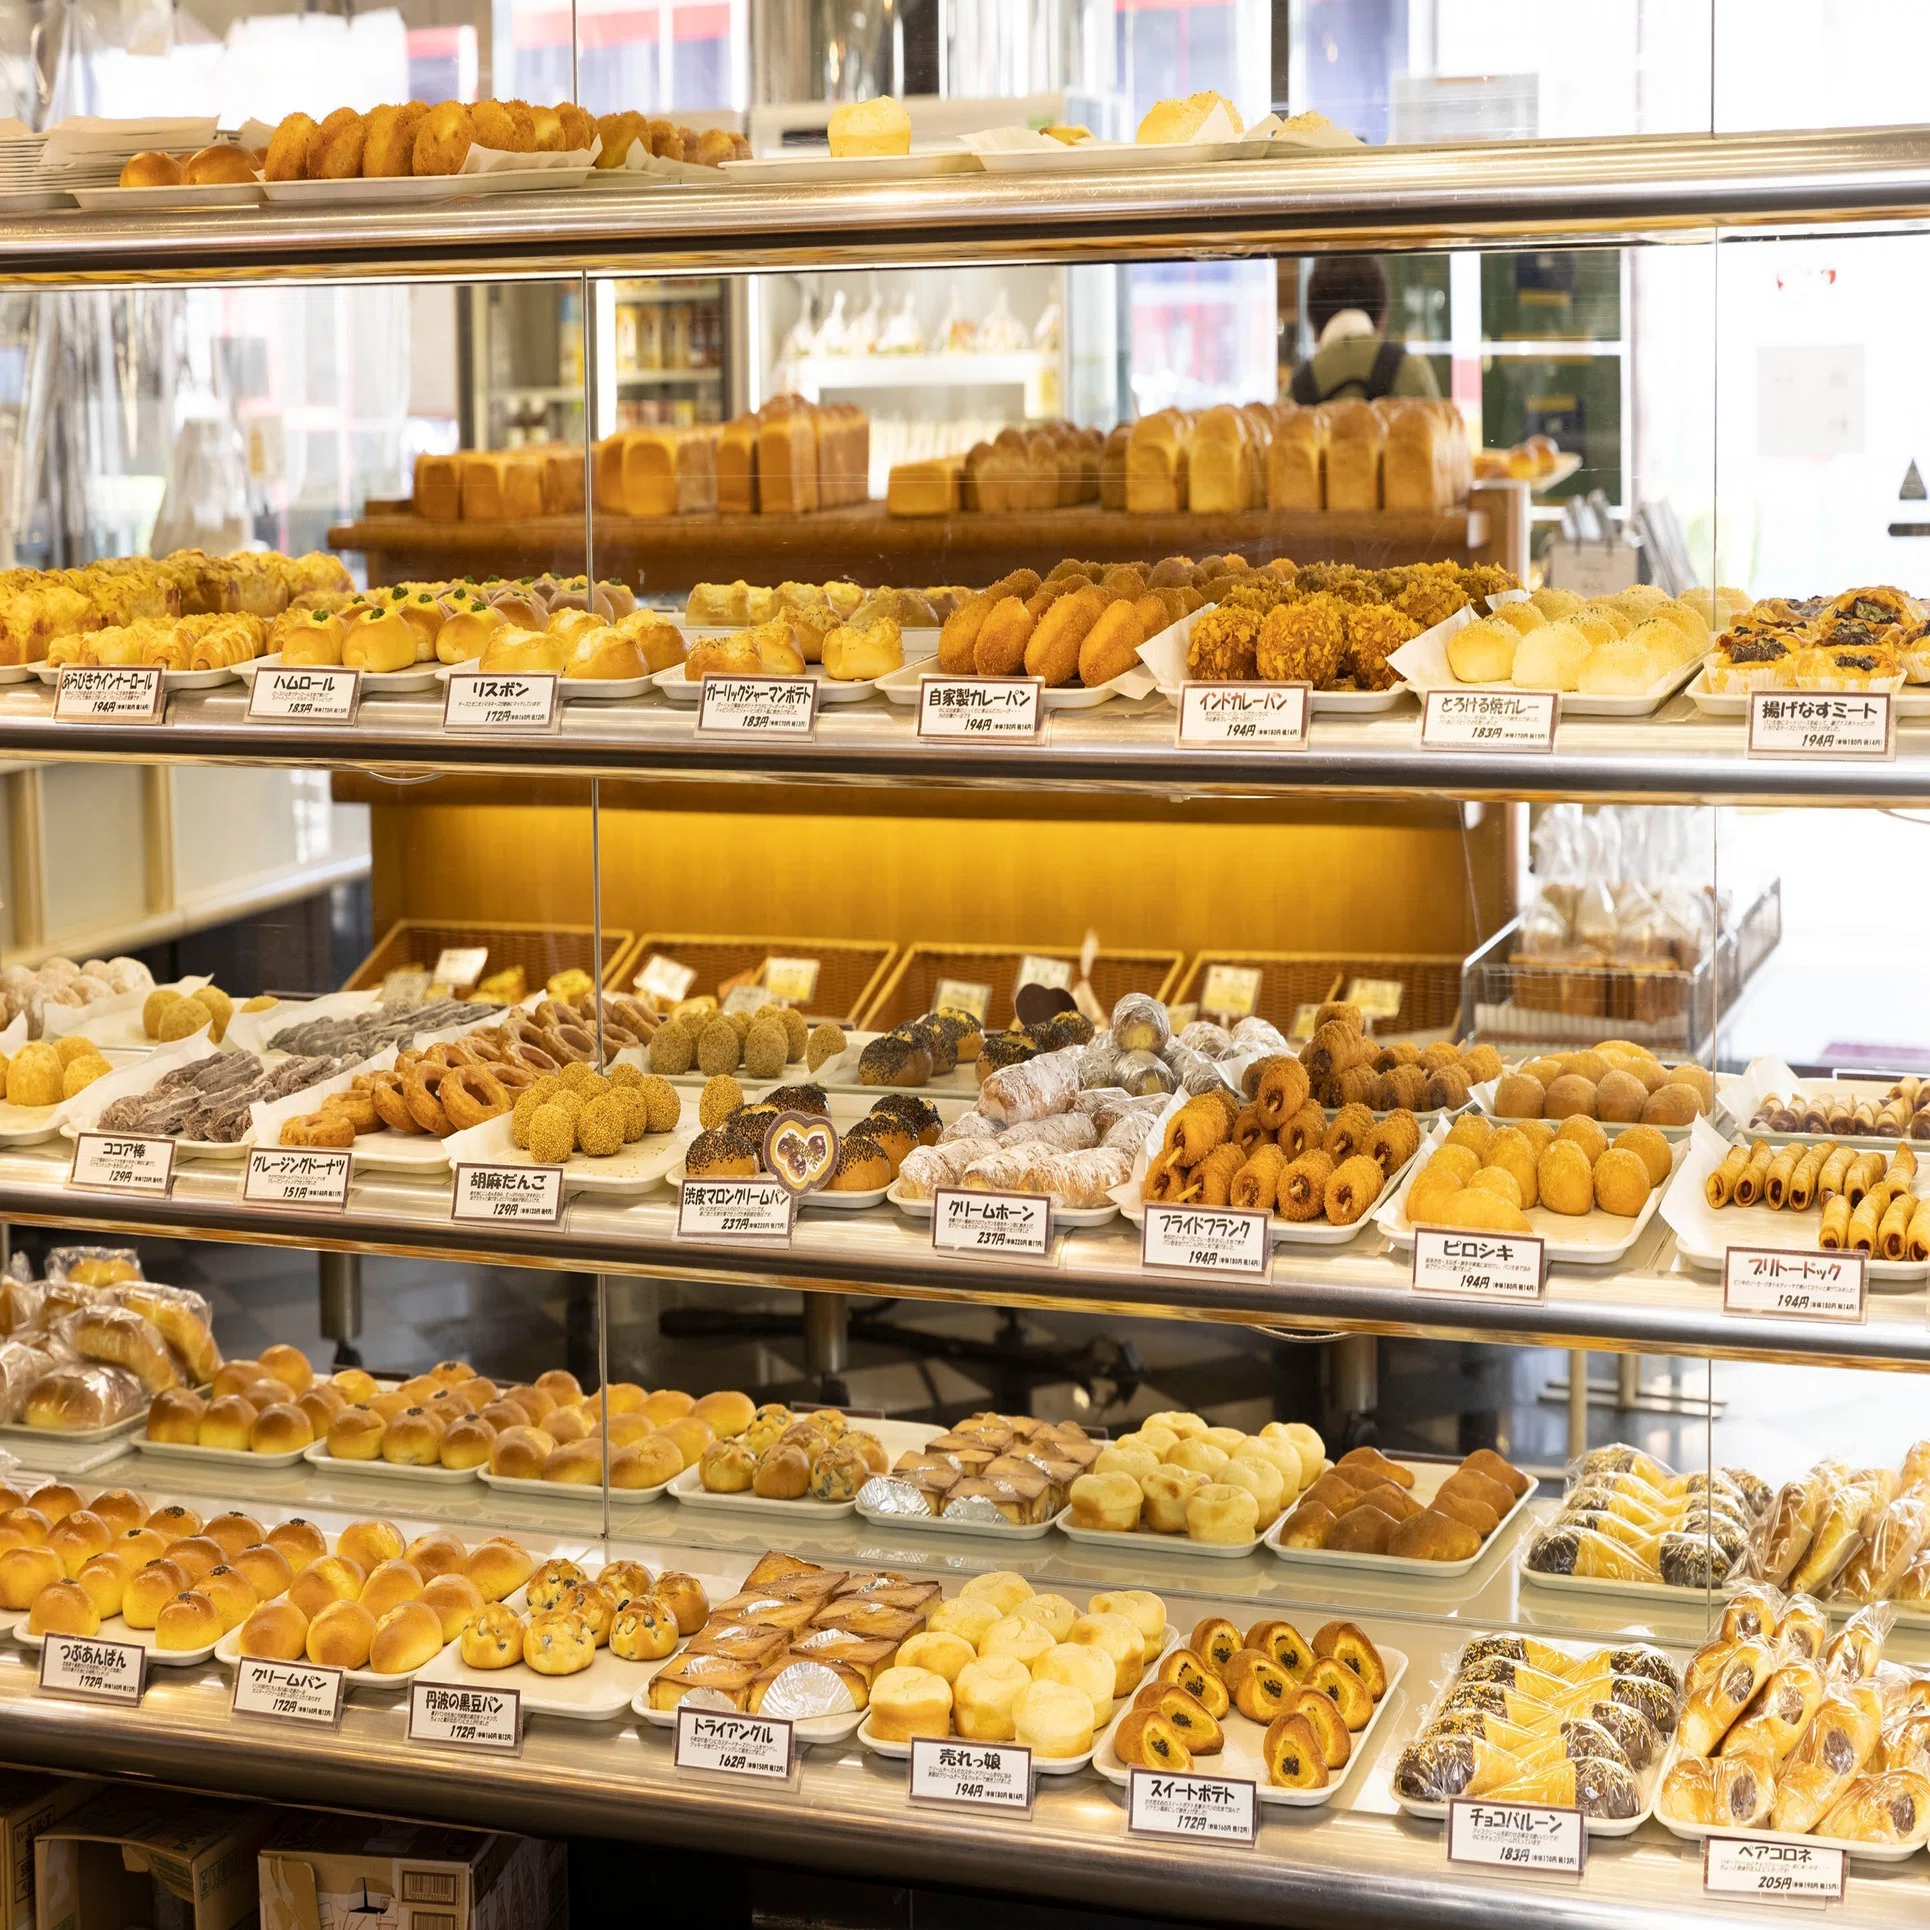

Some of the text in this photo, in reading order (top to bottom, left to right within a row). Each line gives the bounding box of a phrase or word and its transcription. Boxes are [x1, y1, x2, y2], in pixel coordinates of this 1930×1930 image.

[62, 672, 152, 690] あらびきウインナーロール
[273, 675, 335, 691] ハムロール
[473, 682, 529, 697] リスボン
[707, 684, 811, 704] ガーリックジャーマンポテト
[929, 688, 1030, 707] 自家製カレーパン
[1200, 692, 1287, 710] インドカレーパン
[92, 701, 116, 712] 194円
[288, 703, 313, 713] 183円
[1441, 697, 1539, 714] とろける焼カレー
[1762, 700, 1877, 719] 揚げなすミート
[485, 710, 511, 722] 172円
[742, 716, 769, 727] 183円
[965, 719, 992, 730] 194円
[1227, 724, 1256, 736] 194円
[1472, 727, 1502, 738] 183円
[1802, 734, 1834, 747] 194円
[103, 1143, 146, 1158] ココア棒
[253, 1156, 345, 1175] グレージングドーナツ
[109, 1170, 132, 1182] 129円
[470, 1172, 547, 1190] 胡麻だんご
[283, 1186, 308, 1198] 151円
[685, 1187, 789, 1205] 渋皮マロンクリームパン
[493, 1203, 519, 1215] 129円
[949, 1200, 1034, 1222] クリームホーン
[721, 1218, 749, 1230] 237円
[1160, 1215, 1250, 1238] フライドフランク
[977, 1232, 1006, 1245] 237円
[1189, 1251, 1218, 1265] 194円
[1444, 1240, 1514, 1261] ピロシキ
[1748, 1258, 1842, 1281] ブリトードック
[1461, 1275, 1490, 1289] 194円
[1778, 1294, 1810, 1309] 194円
[61, 1645, 126, 1668] つぶあんぱん
[79, 1675, 103, 1688] 172円
[252, 1668, 327, 1690] クリームパン
[273, 1698, 298, 1713] 172円
[426, 1690, 503, 1714] 丹波の黒豆パン
[450, 1725, 476, 1739] 172円
[695, 1717, 773, 1744] トライアングル
[719, 1754, 746, 1769] 162円
[940, 1748, 1001, 1770] 売れっ娘
[955, 1783, 984, 1797] 194円
[1151, 1780, 1235, 1804] スイートポテト
[1177, 1815, 1207, 1831] 172円
[1470, 1808, 1562, 1834] チョコバルーン
[1500, 1847, 1530, 1862] 183円
[1738, 1845, 1812, 1863] ペアコロネ
[1758, 1876, 1792, 1890] 205円
